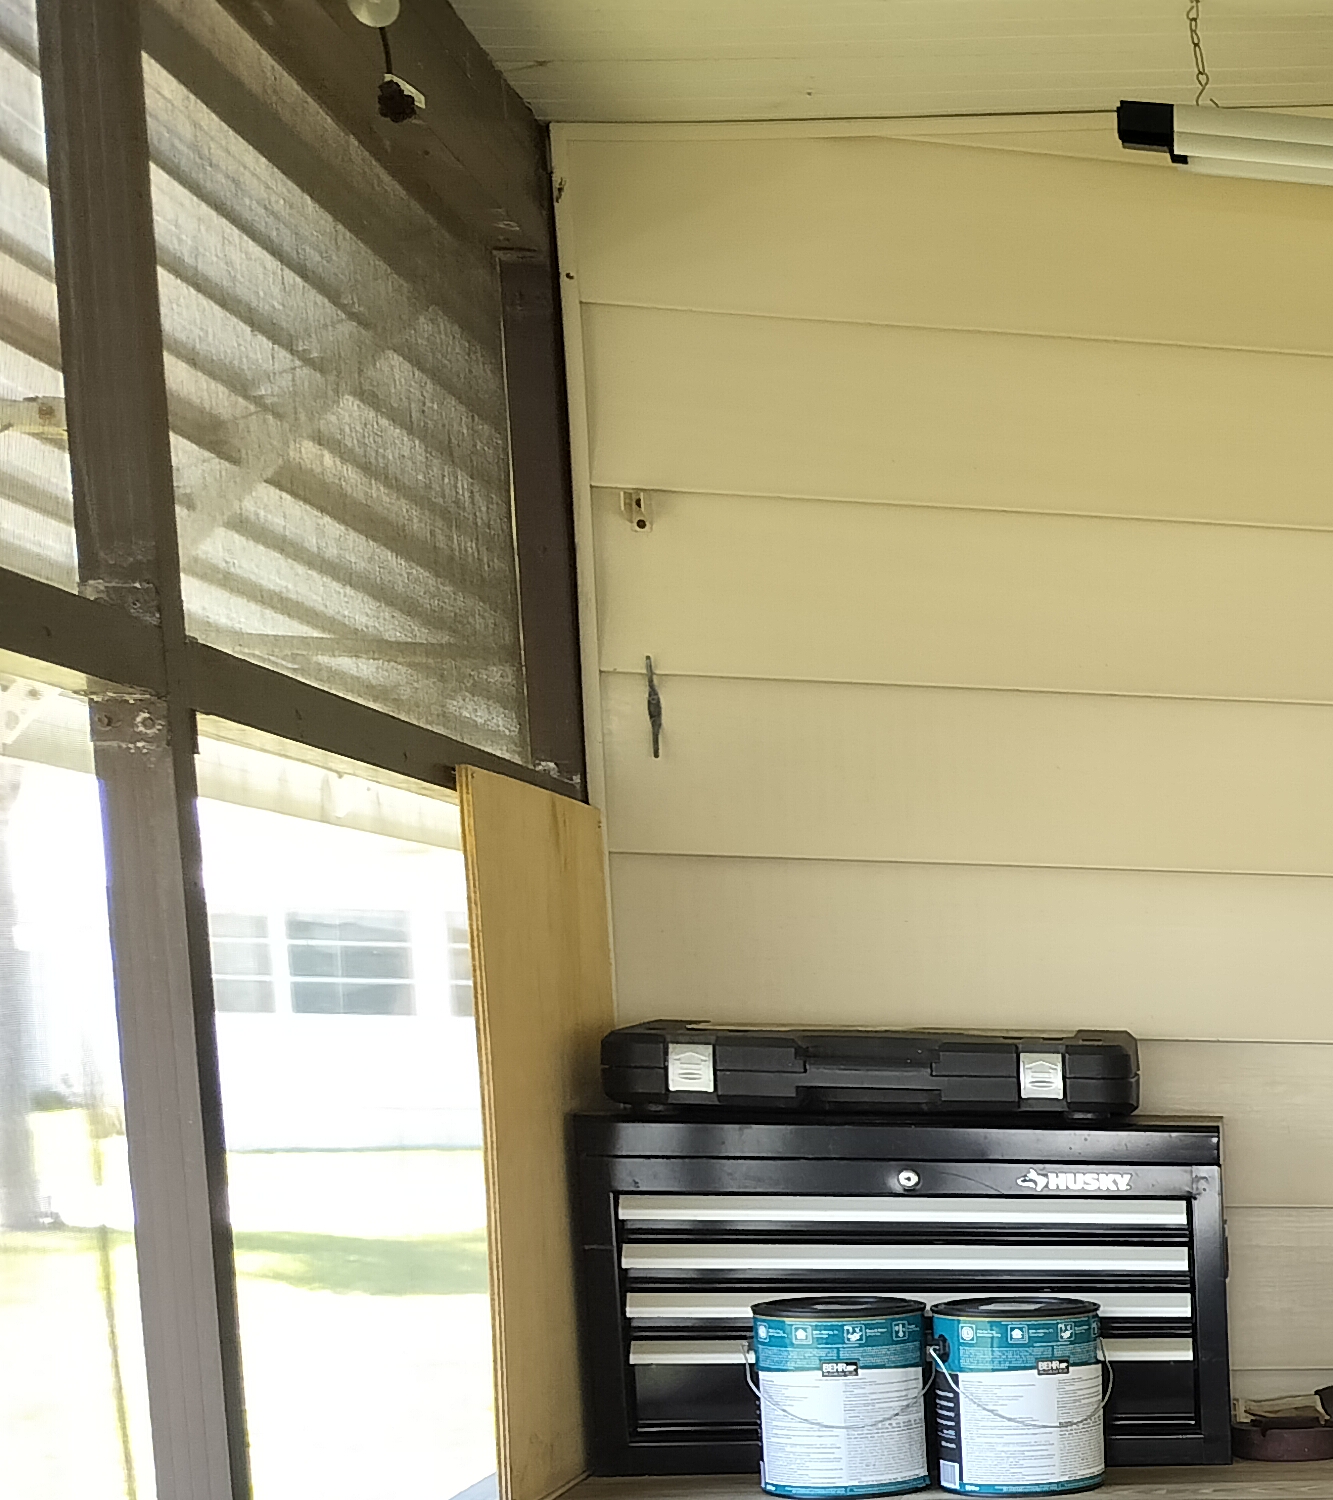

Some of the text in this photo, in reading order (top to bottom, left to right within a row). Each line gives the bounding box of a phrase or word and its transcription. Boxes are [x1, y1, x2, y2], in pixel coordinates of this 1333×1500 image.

[1048, 1172, 1131, 1191] HUSKY
[823, 1363, 847, 1372] BEHR
[1038, 1361, 1060, 1370] BEHR
